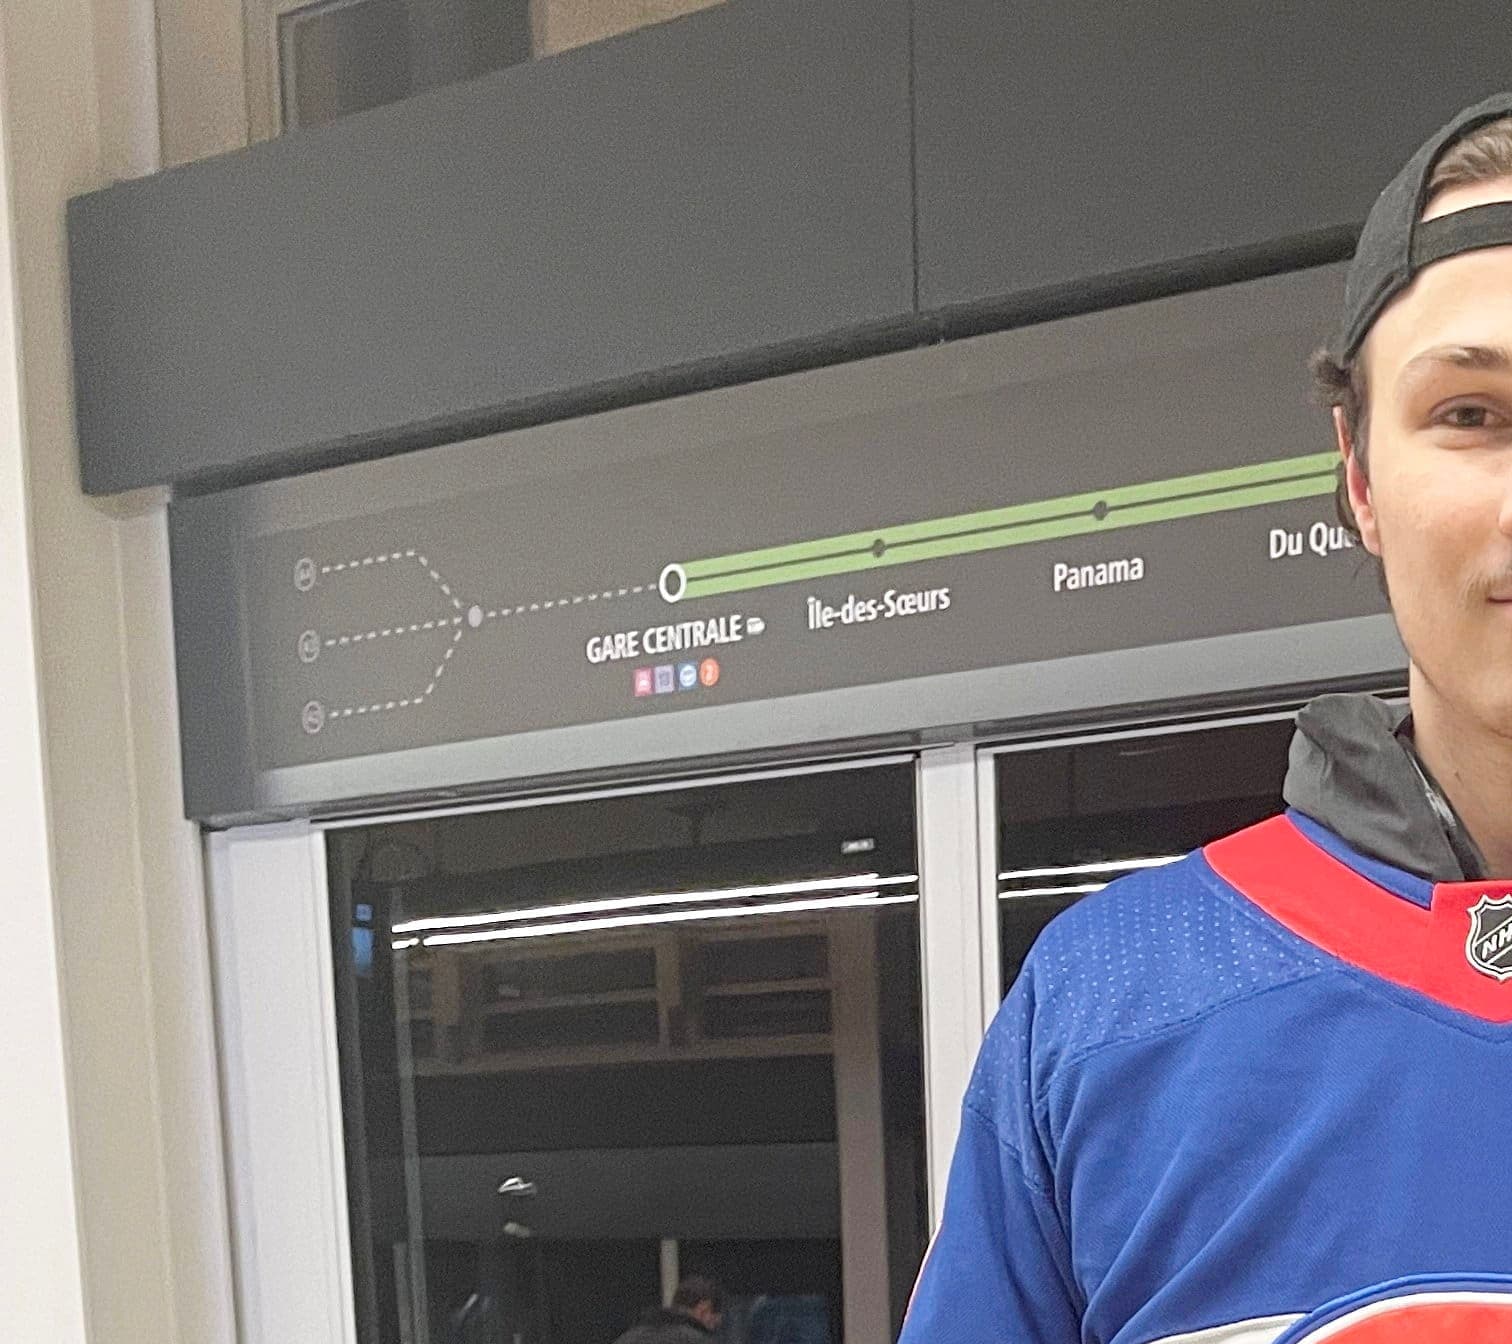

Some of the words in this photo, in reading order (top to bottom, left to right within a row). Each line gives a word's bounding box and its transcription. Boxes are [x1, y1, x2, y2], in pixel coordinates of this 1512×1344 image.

[1269, 528, 1304, 560] Du
[1308, 521, 1354, 557] Qu
[1053, 557, 1145, 593] Panama
[806, 586, 951, 631] Île-des-Sœurs
[585, 630, 640, 664] GARE
[642, 614, 743, 655] CENTRALE
